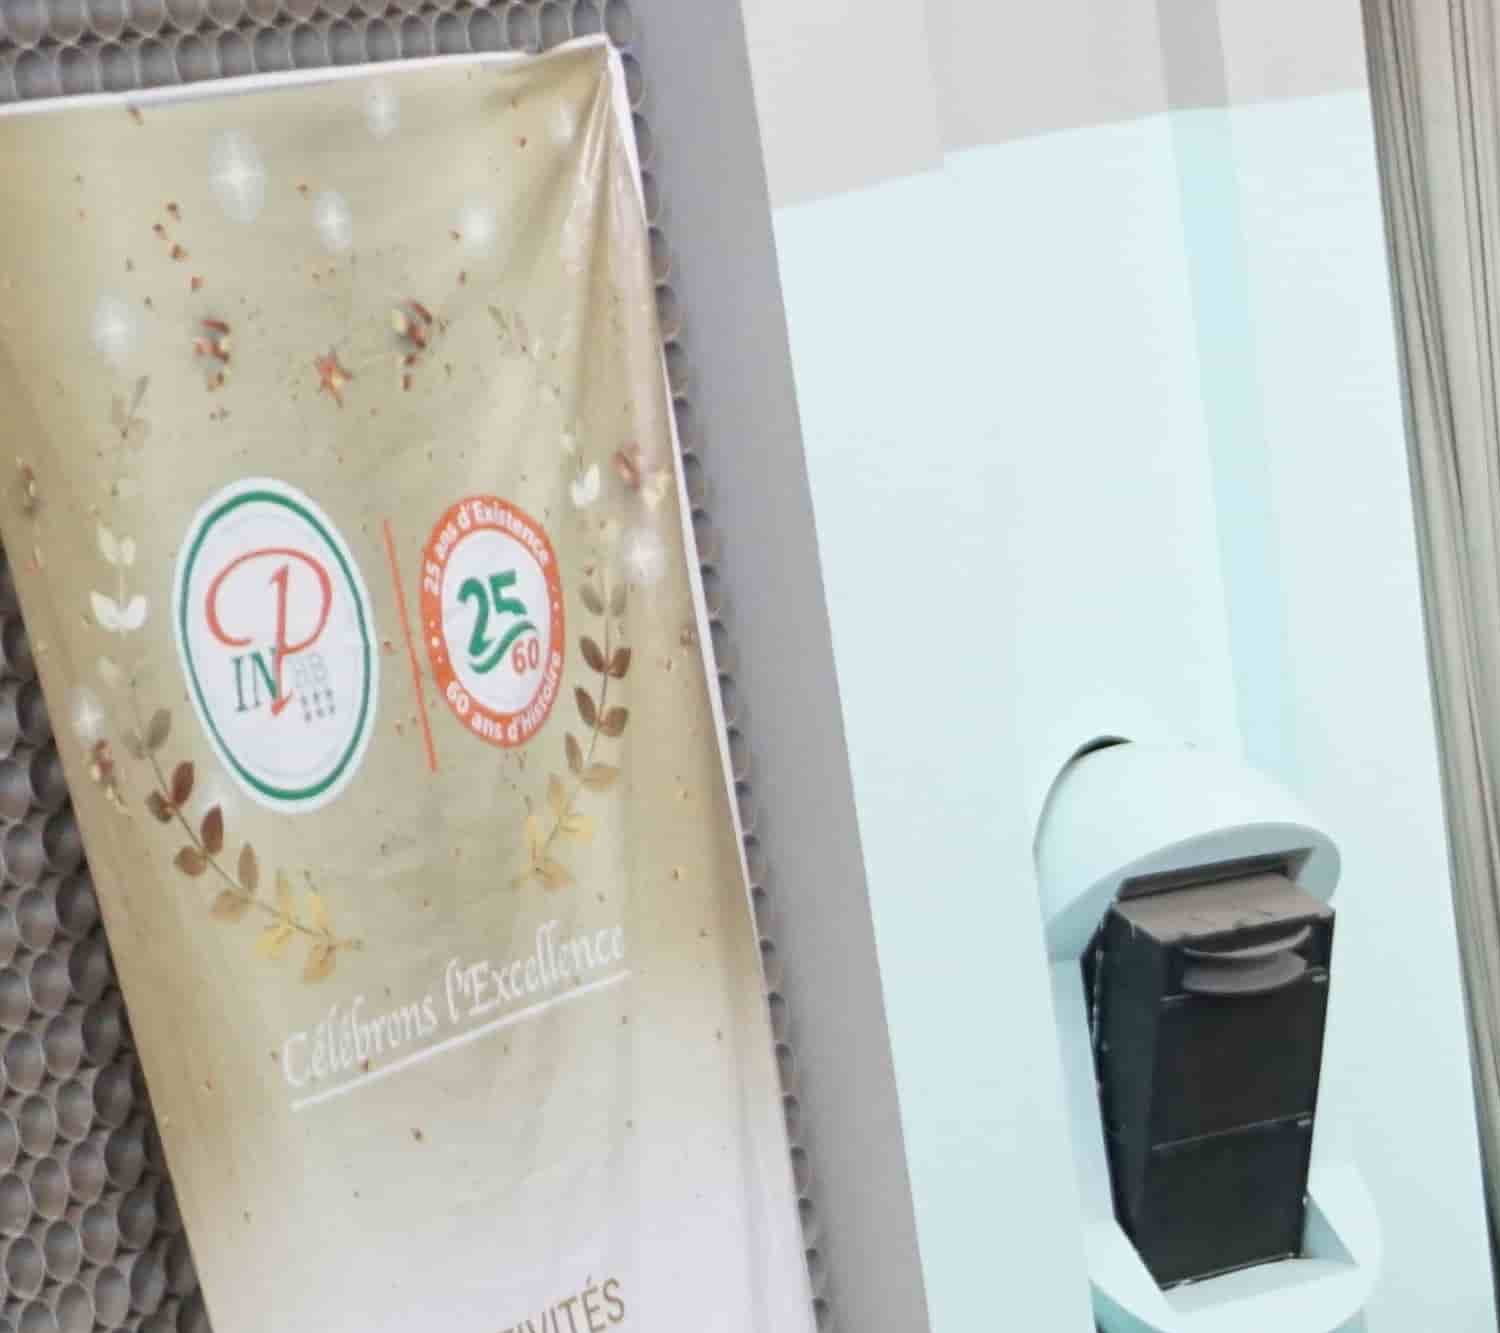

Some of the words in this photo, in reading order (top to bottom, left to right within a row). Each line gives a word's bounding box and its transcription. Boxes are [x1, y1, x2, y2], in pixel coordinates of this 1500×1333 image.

[457, 569, 527, 656] 25
[512, 637, 539, 675] 60
[282, 996, 438, 1089] Célébrons
[444, 921, 625, 1020] l'Excellence
